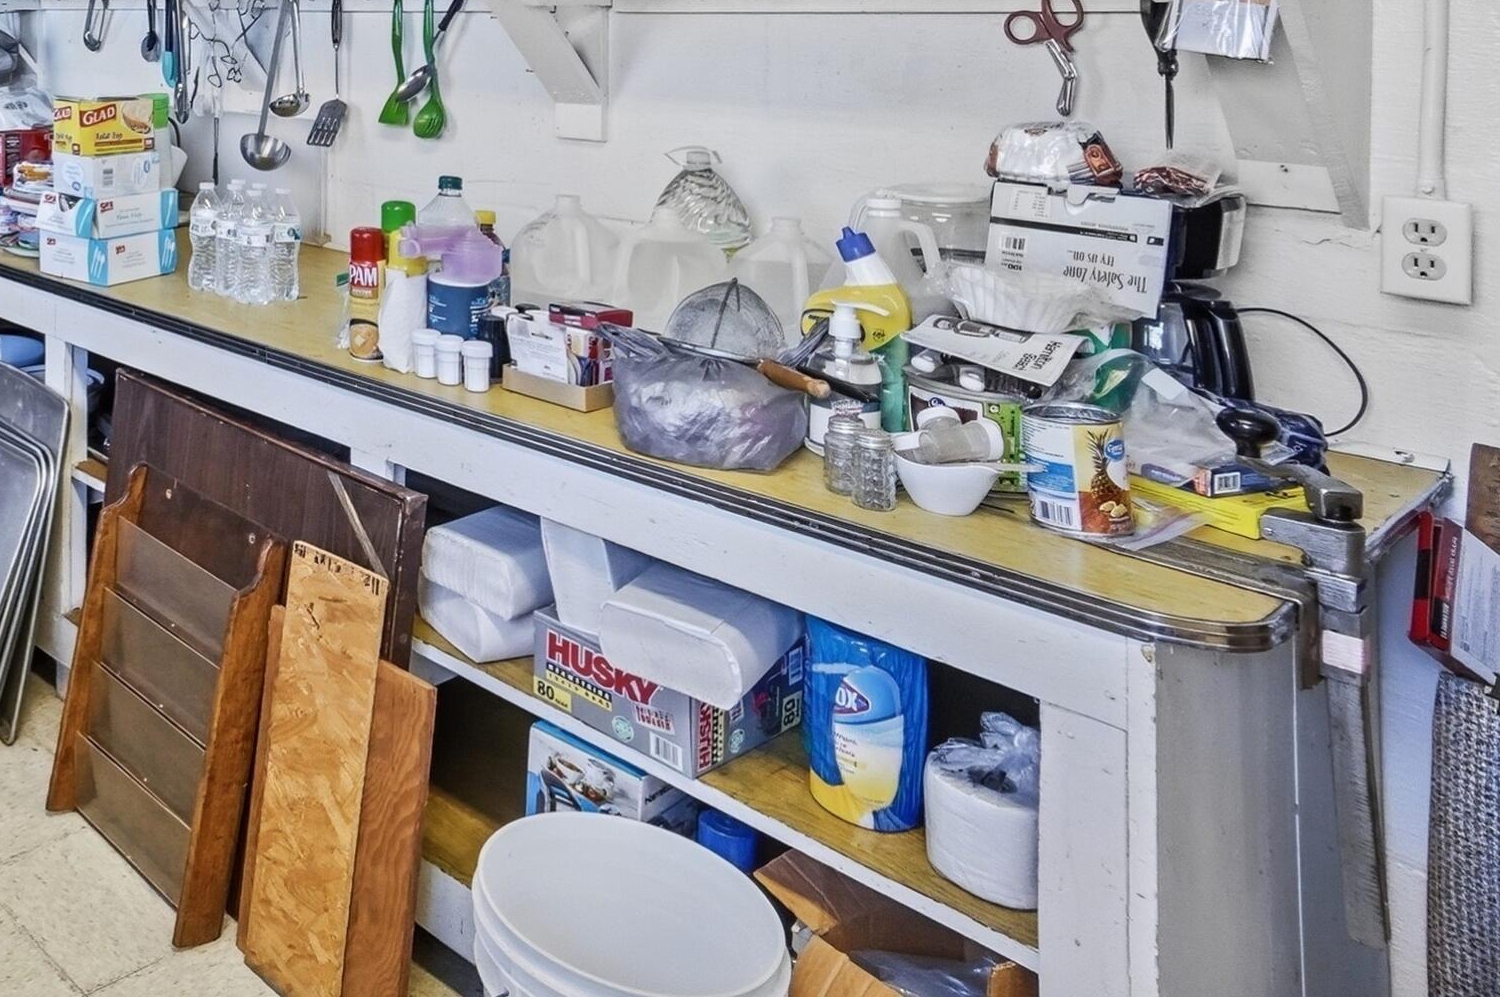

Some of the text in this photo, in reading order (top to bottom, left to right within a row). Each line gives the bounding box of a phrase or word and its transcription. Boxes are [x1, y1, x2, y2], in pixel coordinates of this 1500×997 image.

[82, 106, 116, 125] GLAD
[1088, 252, 1098, 262] us
[1099, 256, 1115, 267] try
[349, 263, 377, 287] PAM
[1062, 264, 1147, 293] The Safety Zone
[546, 630, 660, 705] HUSKY
[537, 679, 555, 701] 80
[783, 697, 796, 726] 80
[698, 702, 713, 769] HUSK
